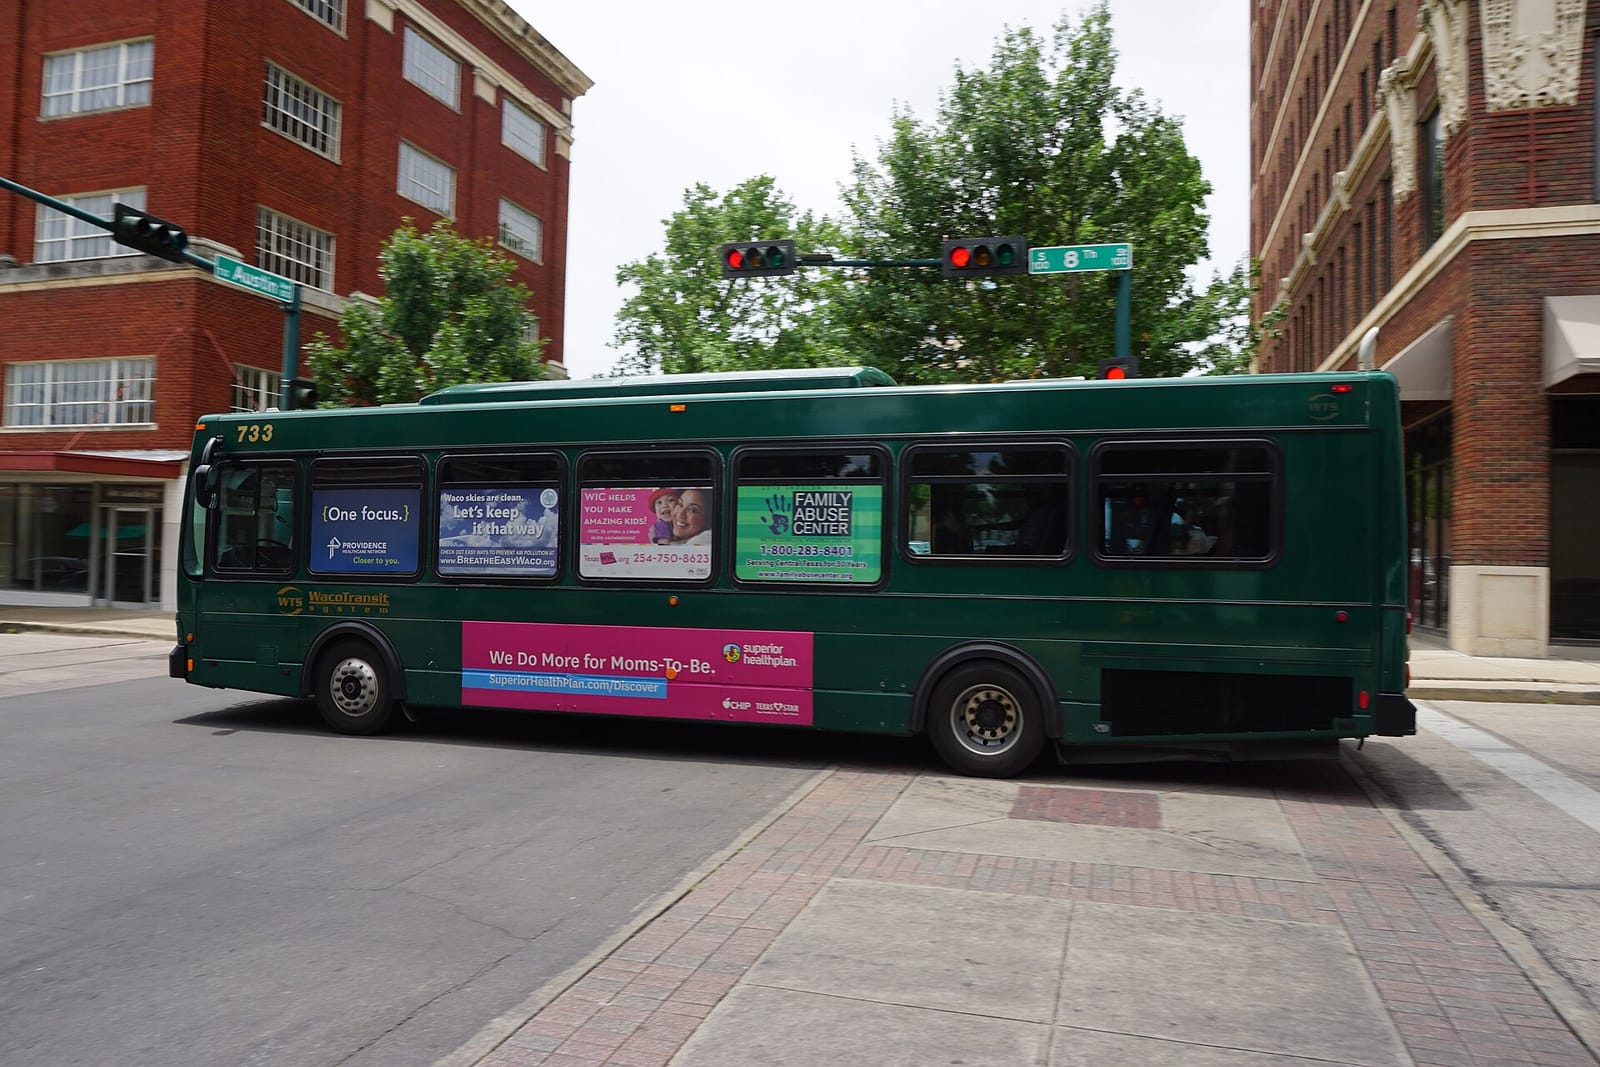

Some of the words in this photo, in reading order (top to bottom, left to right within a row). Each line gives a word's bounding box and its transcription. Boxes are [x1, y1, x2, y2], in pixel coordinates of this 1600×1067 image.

[1037, 252, 1047, 261] S
[232, 266, 278, 294] Austin
[237, 424, 274, 443] 733
[444, 494, 464, 502] Waco
[465, 494, 485, 502] skies
[500, 494, 524, 502] clean.
[584, 493, 606, 501] WIC
[608, 494, 636, 502] HELPS
[795, 493, 852, 507] FAMILY
[453, 505, 483, 518] Let's
[486, 505, 519, 520] keep
[794, 507, 849, 522] ABUSE
[584, 517, 623, 525] AMAZING
[624, 516, 647, 525] KIDS!
[472, 522, 483, 535] it
[485, 522, 514, 535] that
[517, 525, 544, 538] way
[793, 522, 849, 535] CENTER
[342, 542, 387, 550] PROVIDENCE
[760, 545, 853, 556] 1-800-283-8401
[353, 556, 374, 565] Closer
[384, 557, 400, 566] you.
[633, 553, 710, 563] 254-750-8623
[758, 571, 853, 580] www.familyabusecenter.org
[278, 597, 303, 607] WTS
[309, 591, 389, 604] WacoTransit
[743, 643, 784, 655] superior
[489, 650, 513, 665] We
[518, 651, 537, 666] Do
[542, 653, 580, 668] More
[583, 653, 607, 669] for
[611, 656, 716, 674] Moms-To-Be.
[489, 674, 659, 694] SuperiorHealthPlan.com/Discover
[729, 702, 751, 710] CHIP
